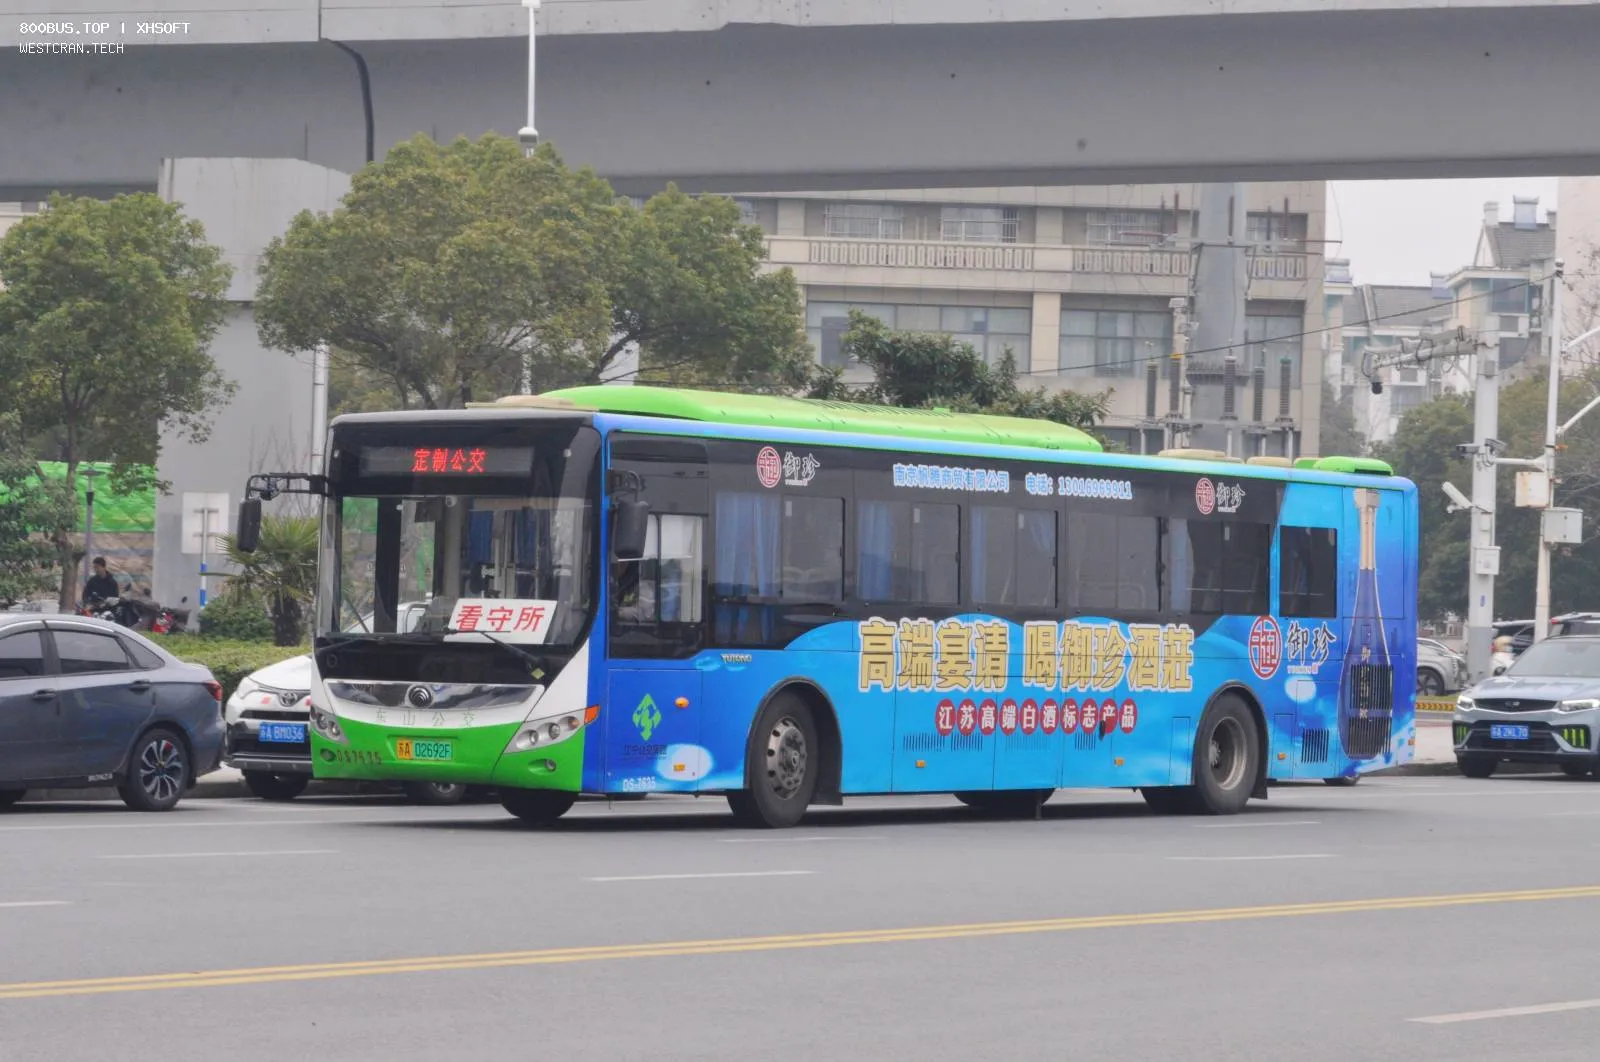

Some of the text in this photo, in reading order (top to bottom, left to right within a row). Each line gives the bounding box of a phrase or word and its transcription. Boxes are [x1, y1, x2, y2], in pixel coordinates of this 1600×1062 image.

[412, 448, 486, 473] 定制公交
[456, 605, 545, 632] 看守所
[858, 616, 1010, 693] 高端宴请
[1285, 620, 1336, 666] 御珍
[938, 702, 1137, 732] 江苏高端白酒标志产品
